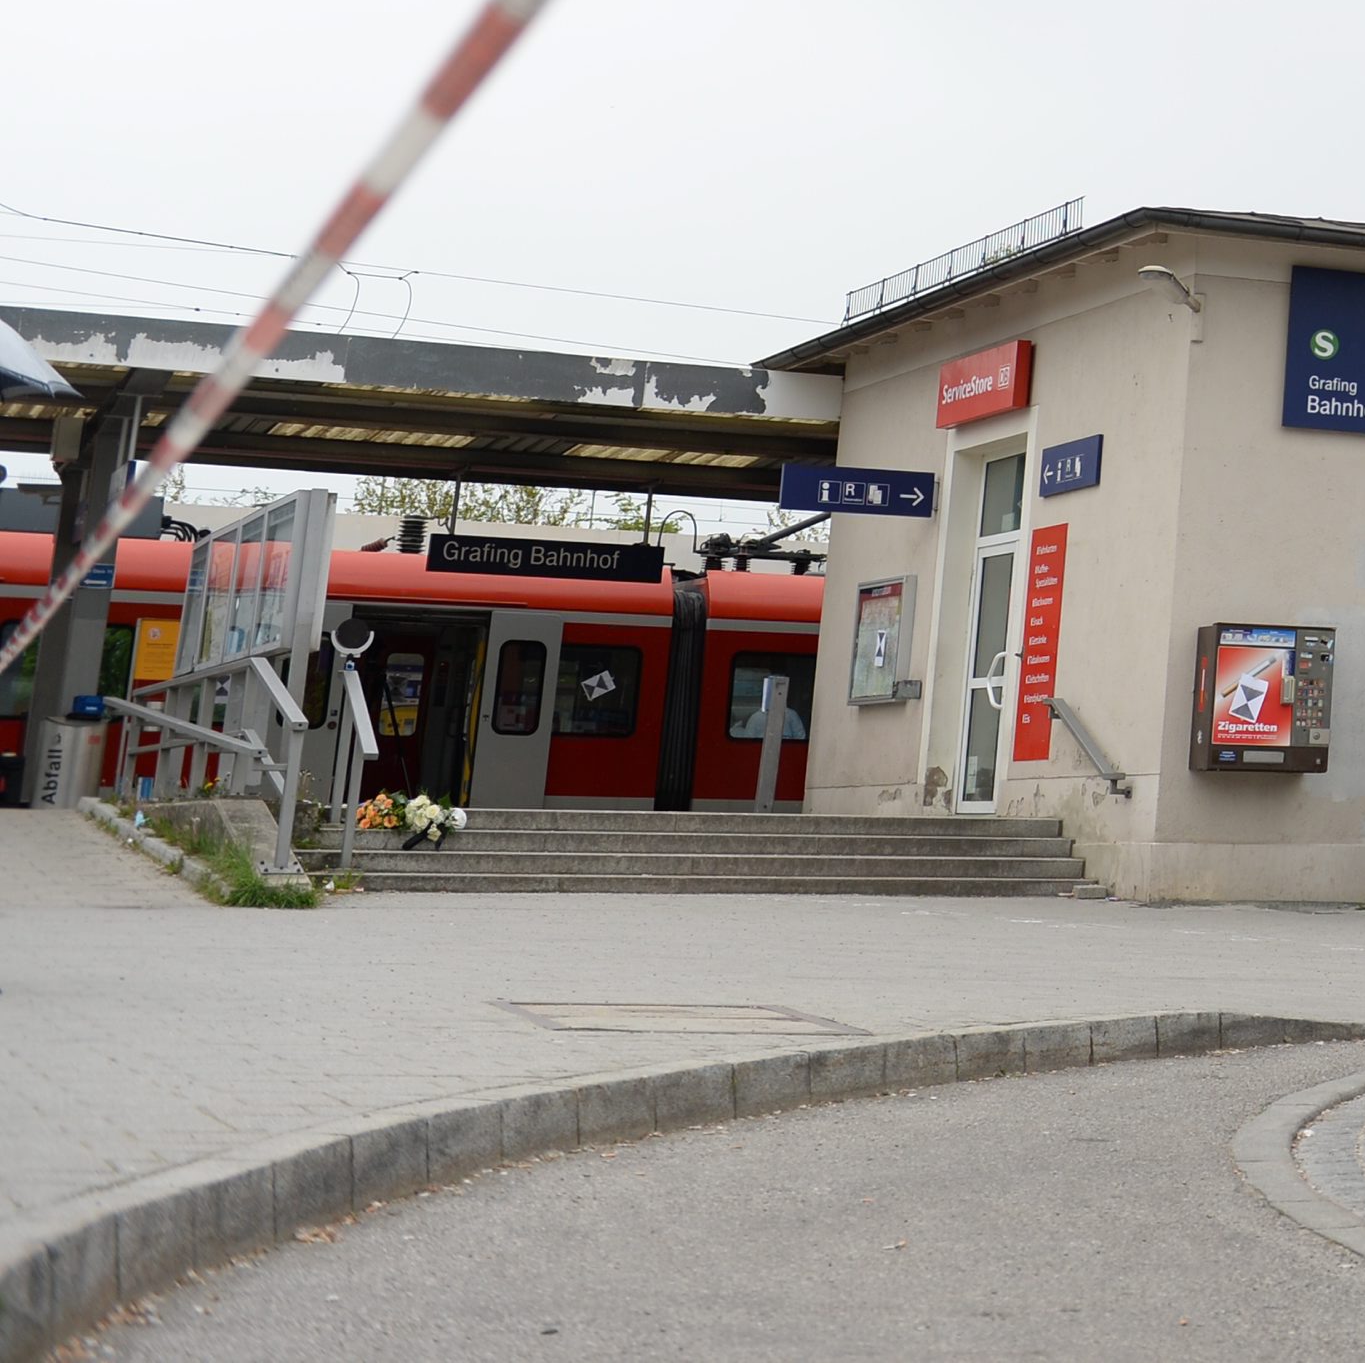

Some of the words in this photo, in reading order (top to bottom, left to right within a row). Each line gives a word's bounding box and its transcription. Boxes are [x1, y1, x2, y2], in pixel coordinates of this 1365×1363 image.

[1313, 331, 1334, 357] S
[942, 374, 993, 405] ServiceStore
[1308, 375, 1358, 396] Grafing
[845, 483, 855, 496] R
[442, 540, 522, 569] Grafing
[530, 546, 621, 569] Bahnhof
[1217, 721, 1278, 733] Zigaretten
[41, 748, 62, 805] Abfall
